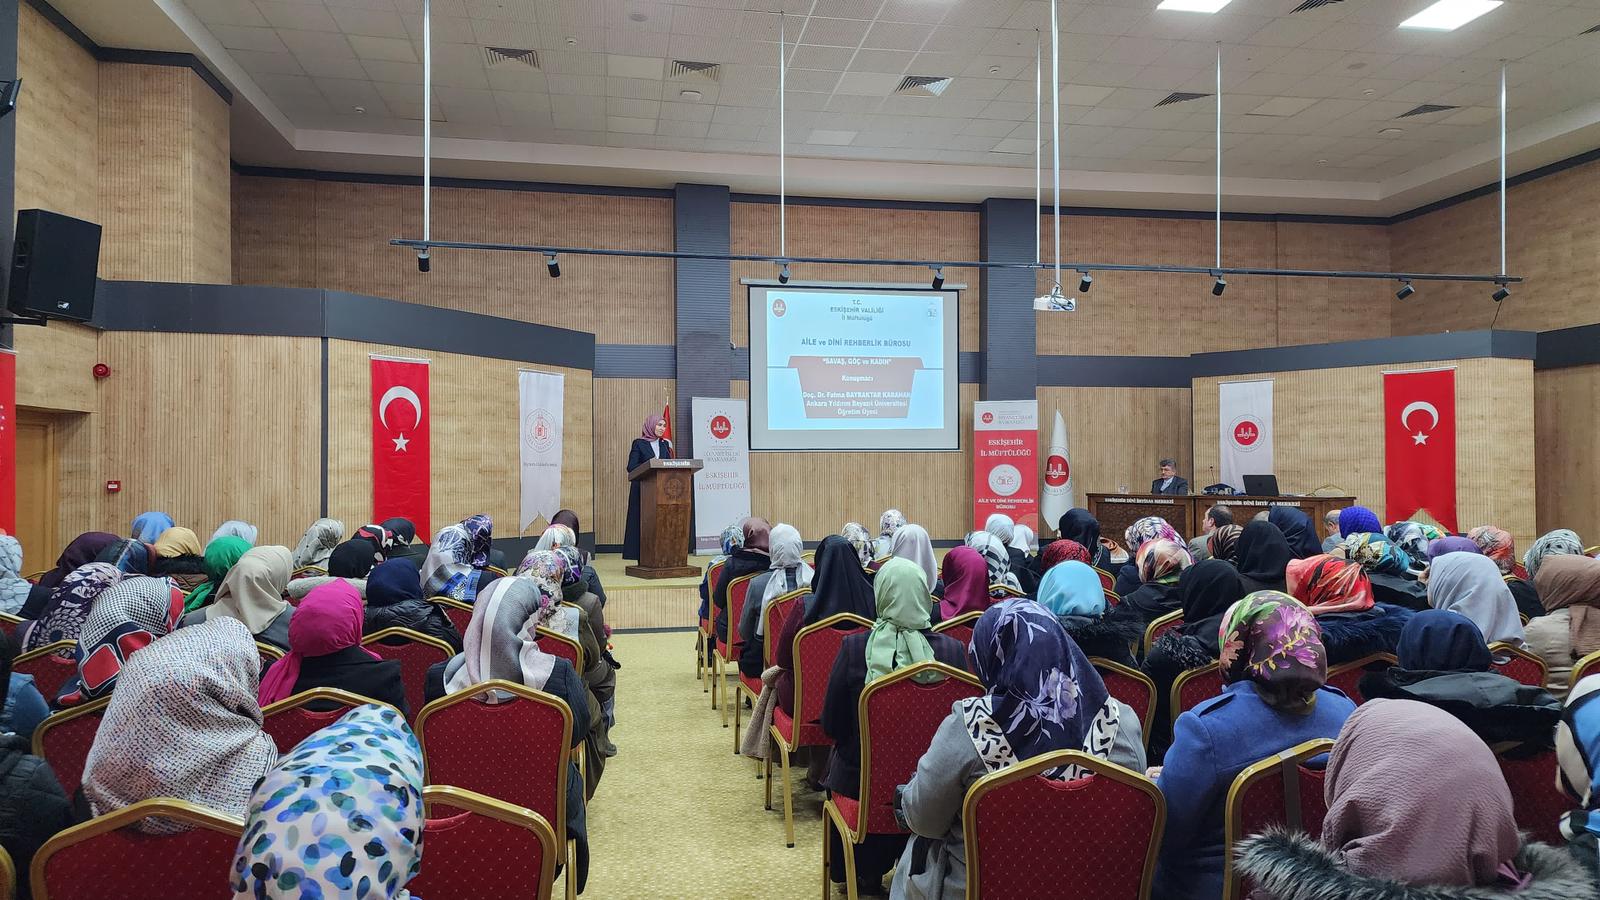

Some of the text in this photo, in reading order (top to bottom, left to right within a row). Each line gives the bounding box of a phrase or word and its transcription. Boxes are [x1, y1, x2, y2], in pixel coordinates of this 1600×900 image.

[801, 338, 817, 346] AİLE
[828, 337, 842, 346] DİNİ
[844, 338, 882, 347] REHBERLİK
[884, 338, 911, 348] BÜROSU
[806, 400, 828, 408] Ankara
[837, 408, 878, 416] Öğretim Üyesi
[988, 438, 1023, 446] ESKİŞEHİR
[988, 449, 1032, 457] MÜFTÜLÜĞÜ
